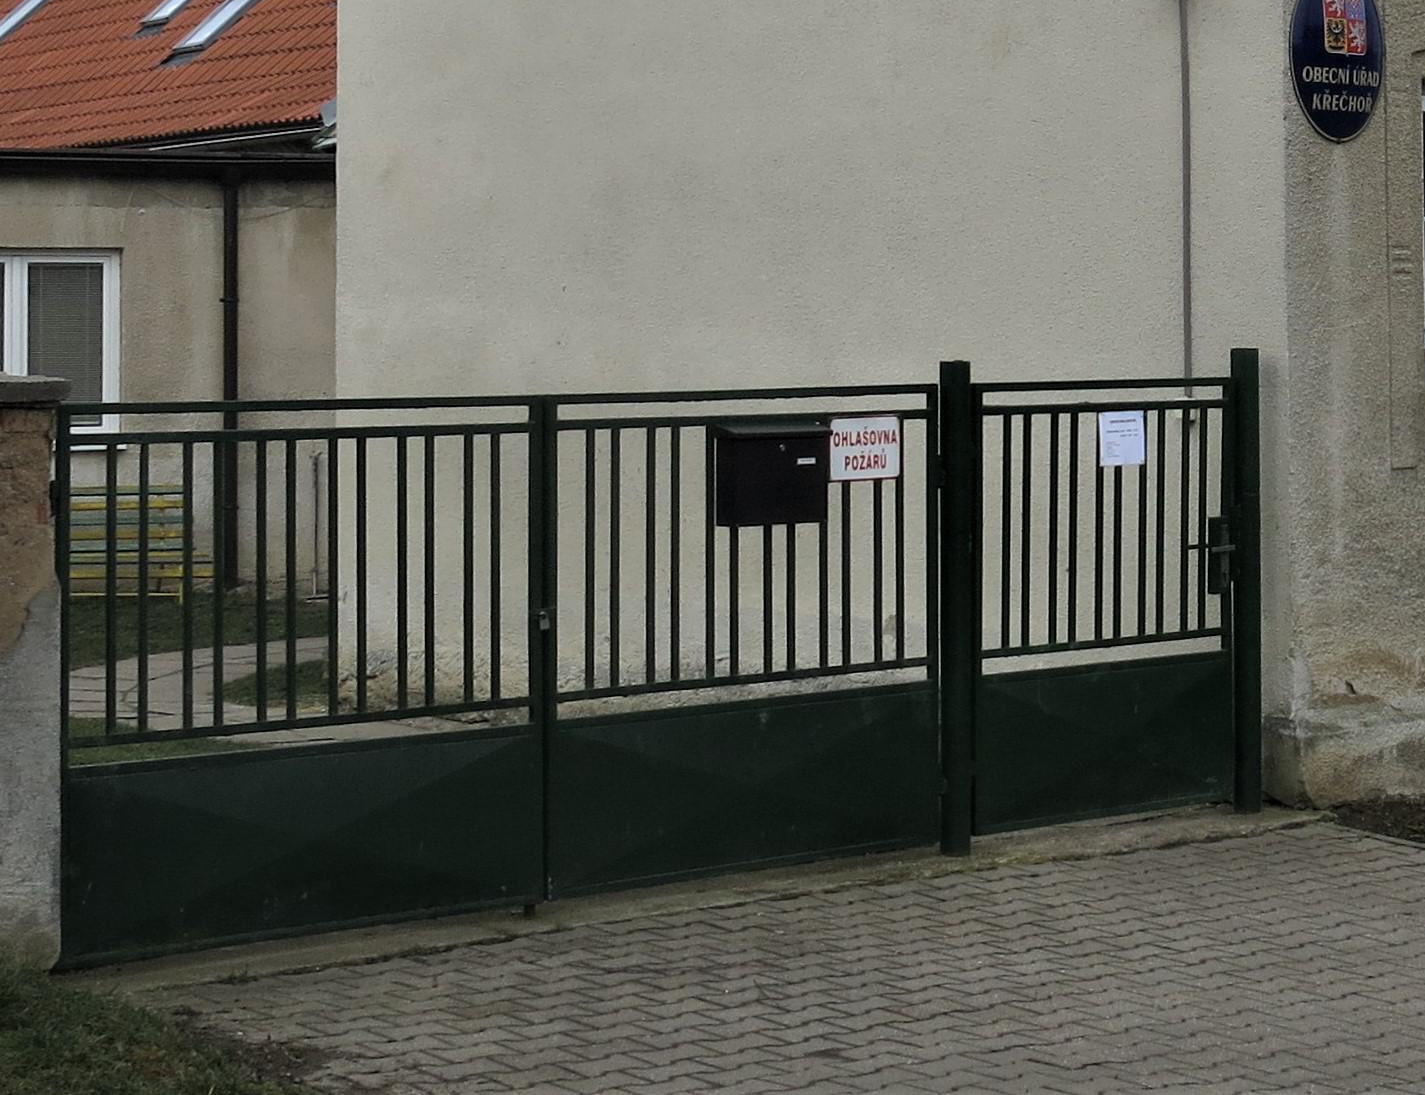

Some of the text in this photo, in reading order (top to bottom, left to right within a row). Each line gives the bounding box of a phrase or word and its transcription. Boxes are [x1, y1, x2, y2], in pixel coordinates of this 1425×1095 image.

[1302, 64, 1380, 87] OBECNÍ ÚŘAD
[1312, 88, 1373, 113] KŘEČHOŘ
[833, 425, 898, 447] OHLAŠOVNA
[844, 448, 887, 471] POŽÁRŮ
